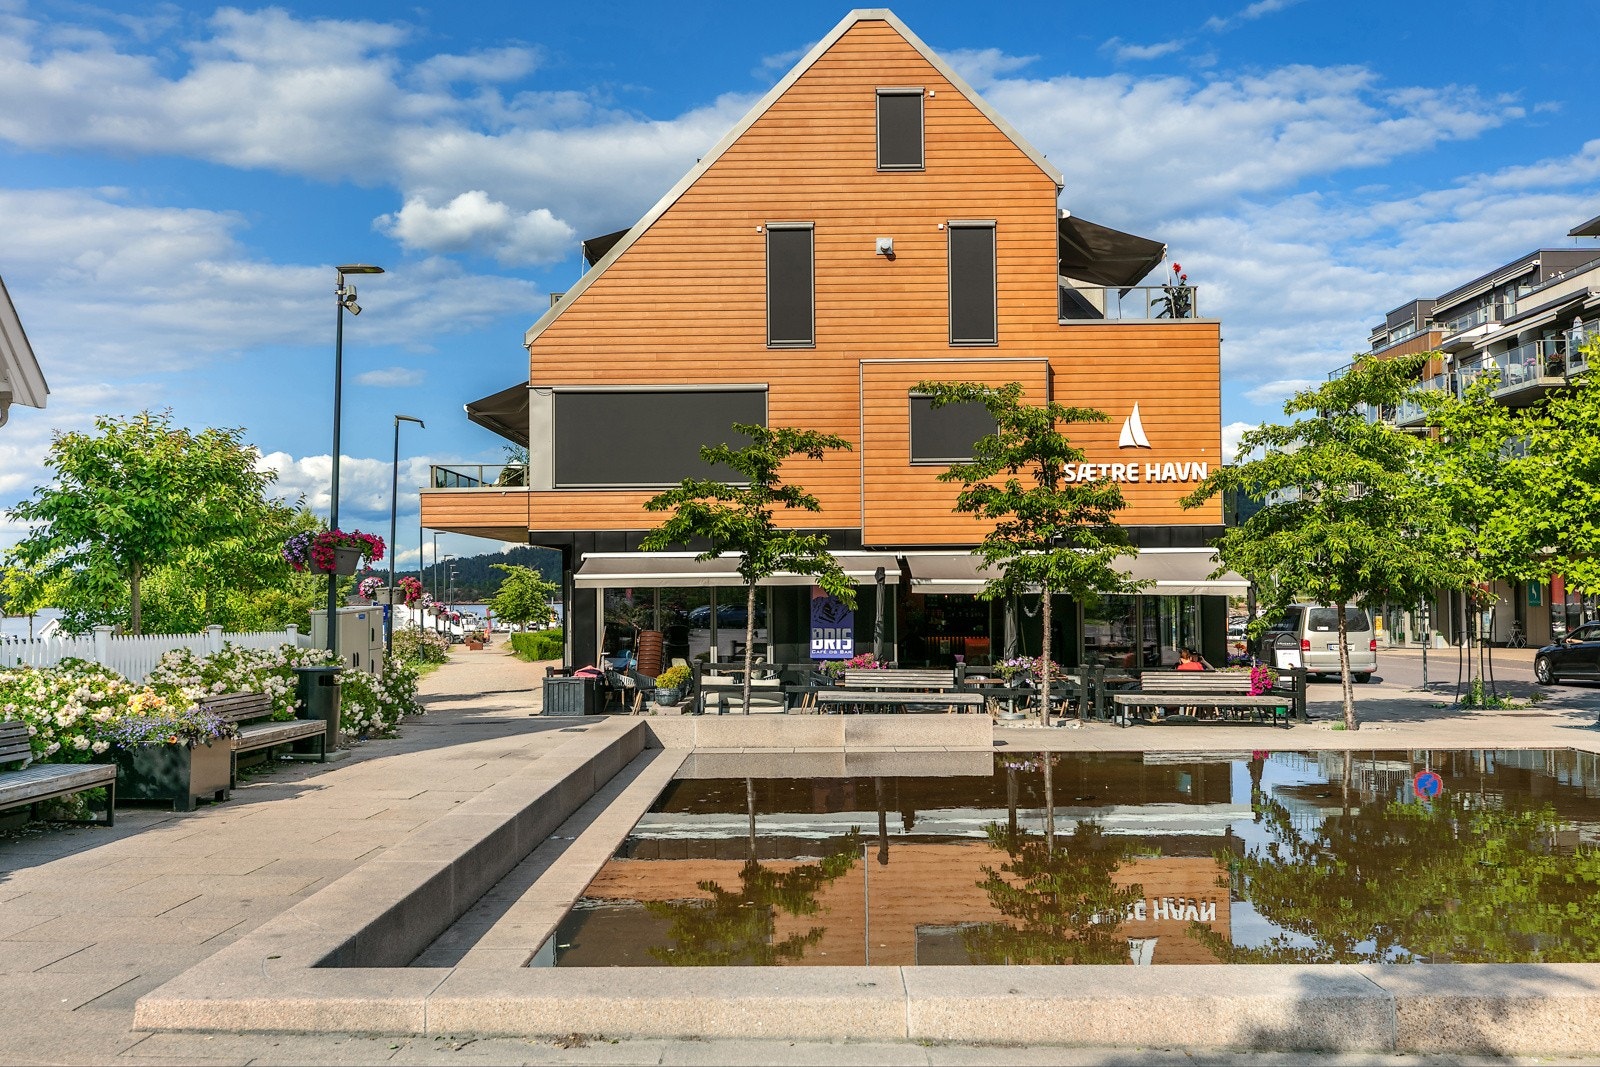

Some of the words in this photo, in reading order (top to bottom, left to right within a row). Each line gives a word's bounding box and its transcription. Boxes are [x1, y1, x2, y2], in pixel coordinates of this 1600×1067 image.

[1063, 462, 1139, 482] SÆTRE
[1145, 462, 1208, 482] HAVN
[811, 628, 852, 650] BRIS
